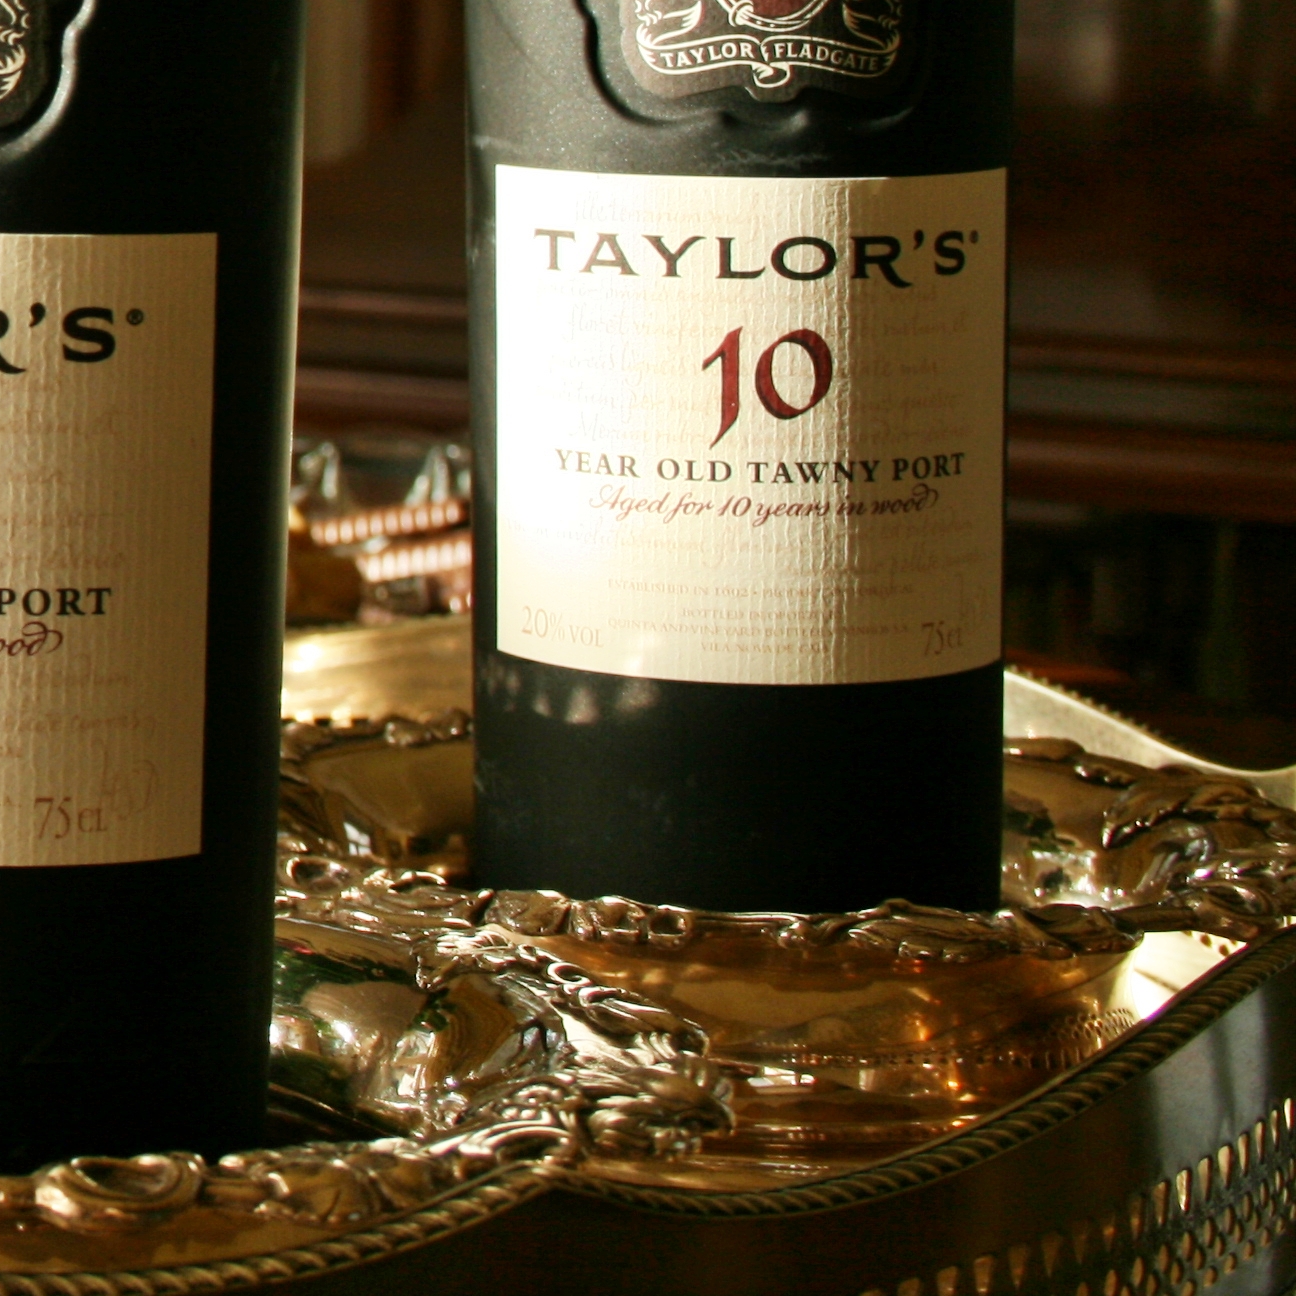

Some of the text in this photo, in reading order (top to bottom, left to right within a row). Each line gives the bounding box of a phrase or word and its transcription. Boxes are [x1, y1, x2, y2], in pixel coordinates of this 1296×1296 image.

[660, 42, 879, 72] TAYLOR FLADGATE
[702, 326, 833, 449] 10
[555, 448, 966, 484] YEAR OLD TAWNY PORT
[589, 483, 939, 527] Aged for 10 years in wood
[521, 605, 605, 648] 20% VOL
[34, 796, 72, 839] 75
